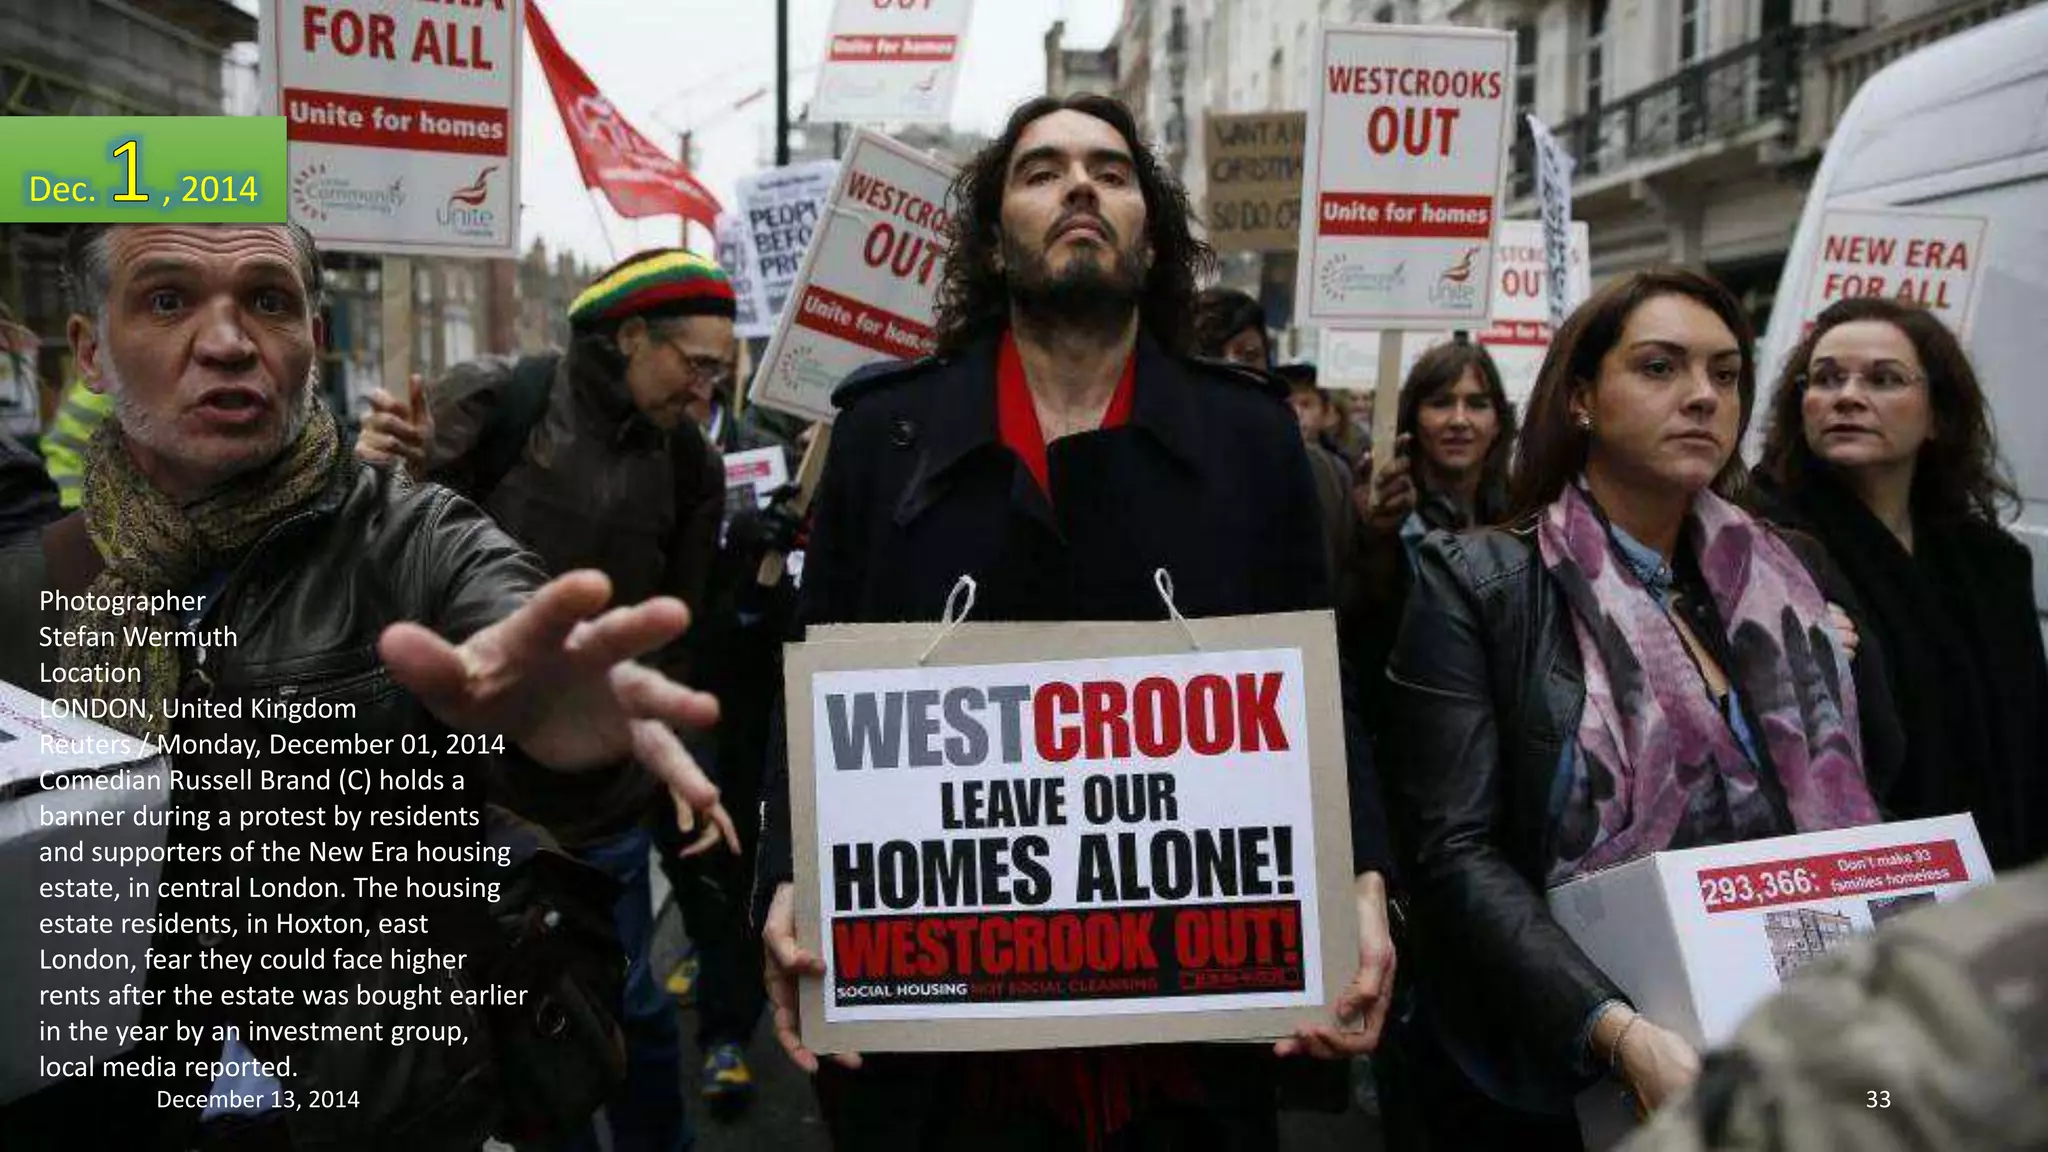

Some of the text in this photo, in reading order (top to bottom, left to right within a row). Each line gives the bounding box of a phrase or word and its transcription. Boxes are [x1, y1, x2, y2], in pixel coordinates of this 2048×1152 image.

[303, 6, 493, 70] FOR ALL
[1328, 65, 1502, 99] WESTCROOKS
[290, 101, 504, 139] Unite for homes
[1367, 105, 1460, 157] OUT
[848, 170, 955, 235] WESTCRO
[1324, 202, 1489, 225] Unite for homes
[755, 225, 814, 256] BEFO
[864, 222, 943, 285] OUT
[1825, 235, 1967, 270] NEW ERA
[1825, 275, 1950, 309] FOR ALL
[803, 295, 850, 327] Unite
[853, 312, 885, 336] for
[826, 672, 1290, 771] WESTCROOK
[940, 772, 1179, 830] LEAVE OUR
[832, 826, 1295, 910] HOMES ALONE!
[1701, 867, 1821, 906] 293,366:
[834, 907, 1298, 980] WESTCROOK OUT!
[837, 986, 892, 999] SOCIAL
[897, 983, 968, 997] HOUSING
